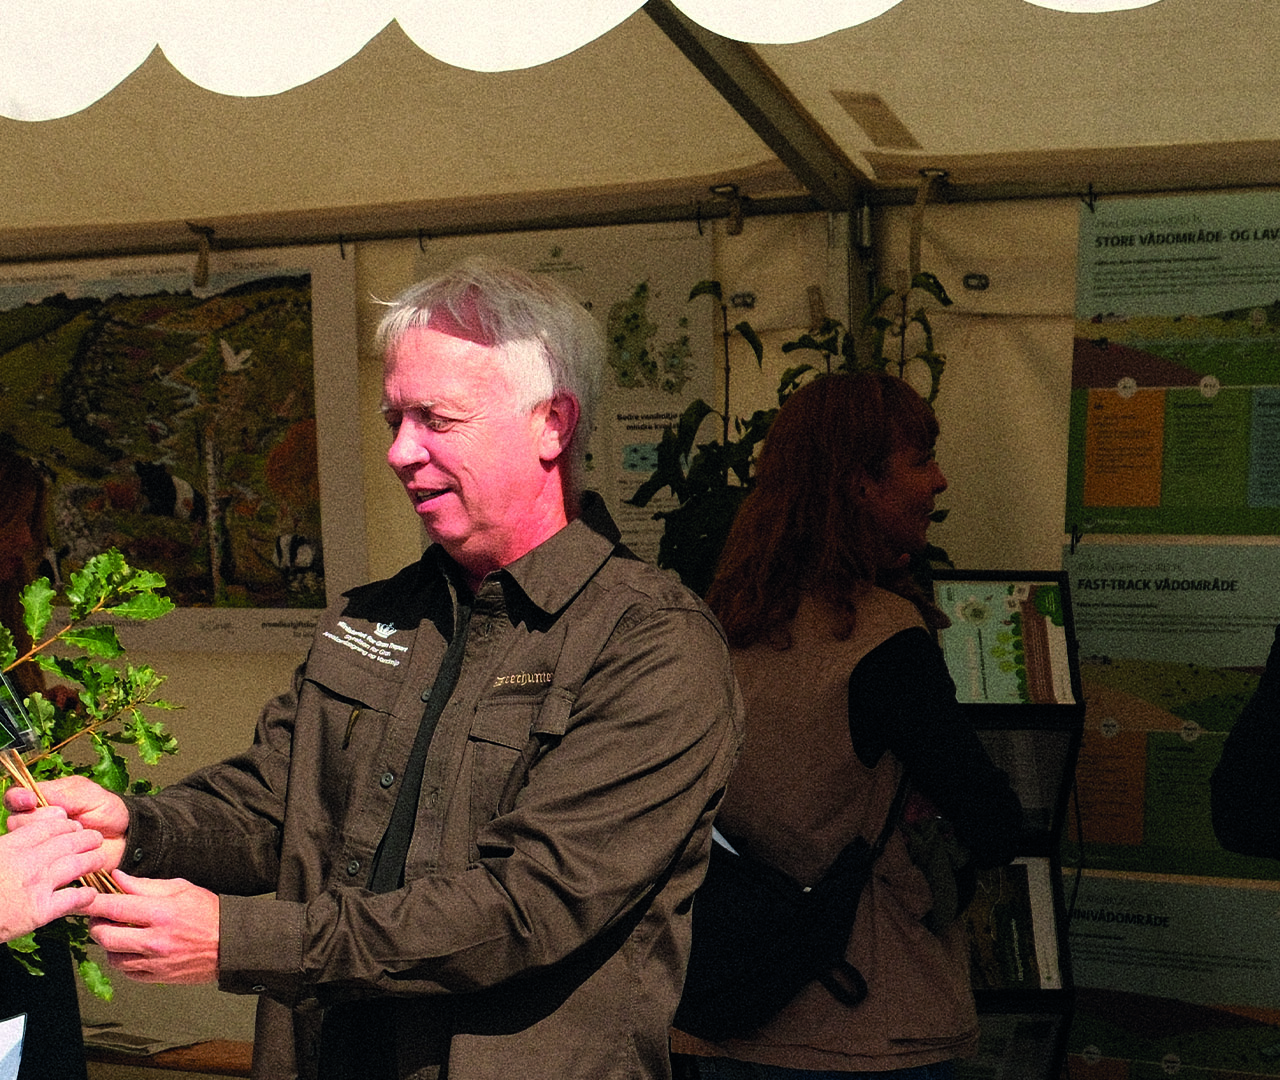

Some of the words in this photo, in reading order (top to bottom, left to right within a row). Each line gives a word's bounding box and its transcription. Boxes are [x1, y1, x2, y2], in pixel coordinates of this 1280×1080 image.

[1094, 233, 1135, 248] STORE
[1138, 229, 1227, 246] VÅDOMRÅDE-
[1229, 228, 1250, 242] OG
[1077, 577, 1152, 592] FAST-TRACK
[1154, 576, 1239, 593] VÅDOMRÅDE
